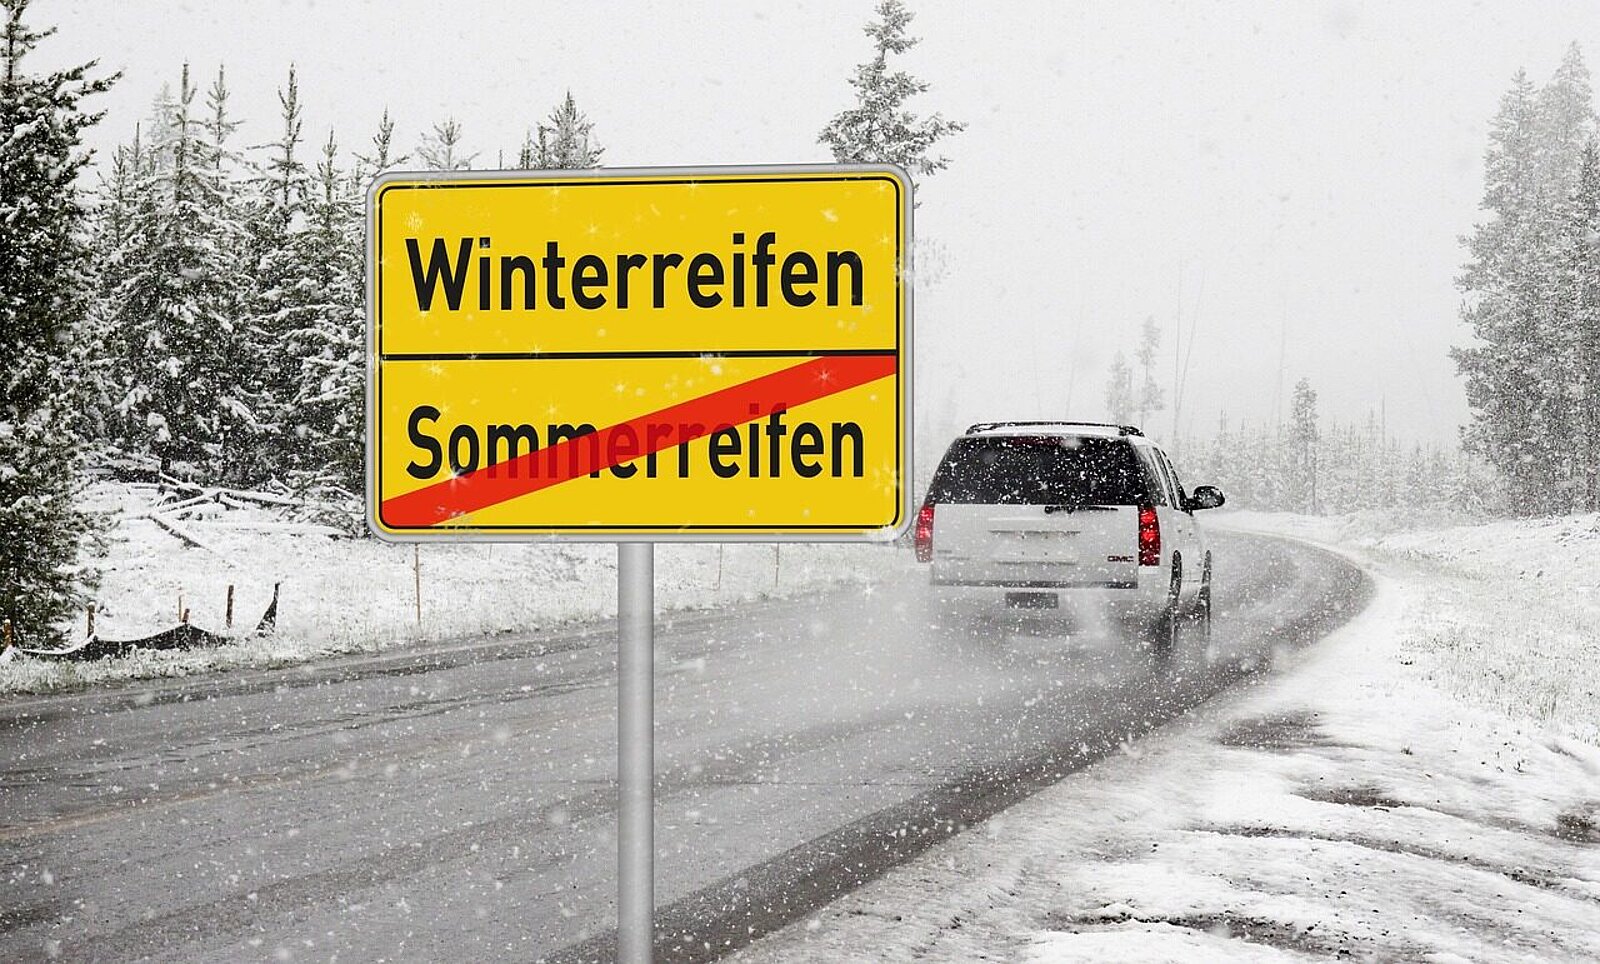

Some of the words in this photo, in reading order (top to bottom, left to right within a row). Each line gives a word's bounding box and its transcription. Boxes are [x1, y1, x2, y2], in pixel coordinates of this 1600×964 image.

[405, 232, 864, 311] Winterreifen
[405, 403, 864, 479] Sommerreifen
[1107, 555, 1134, 563] GMC
